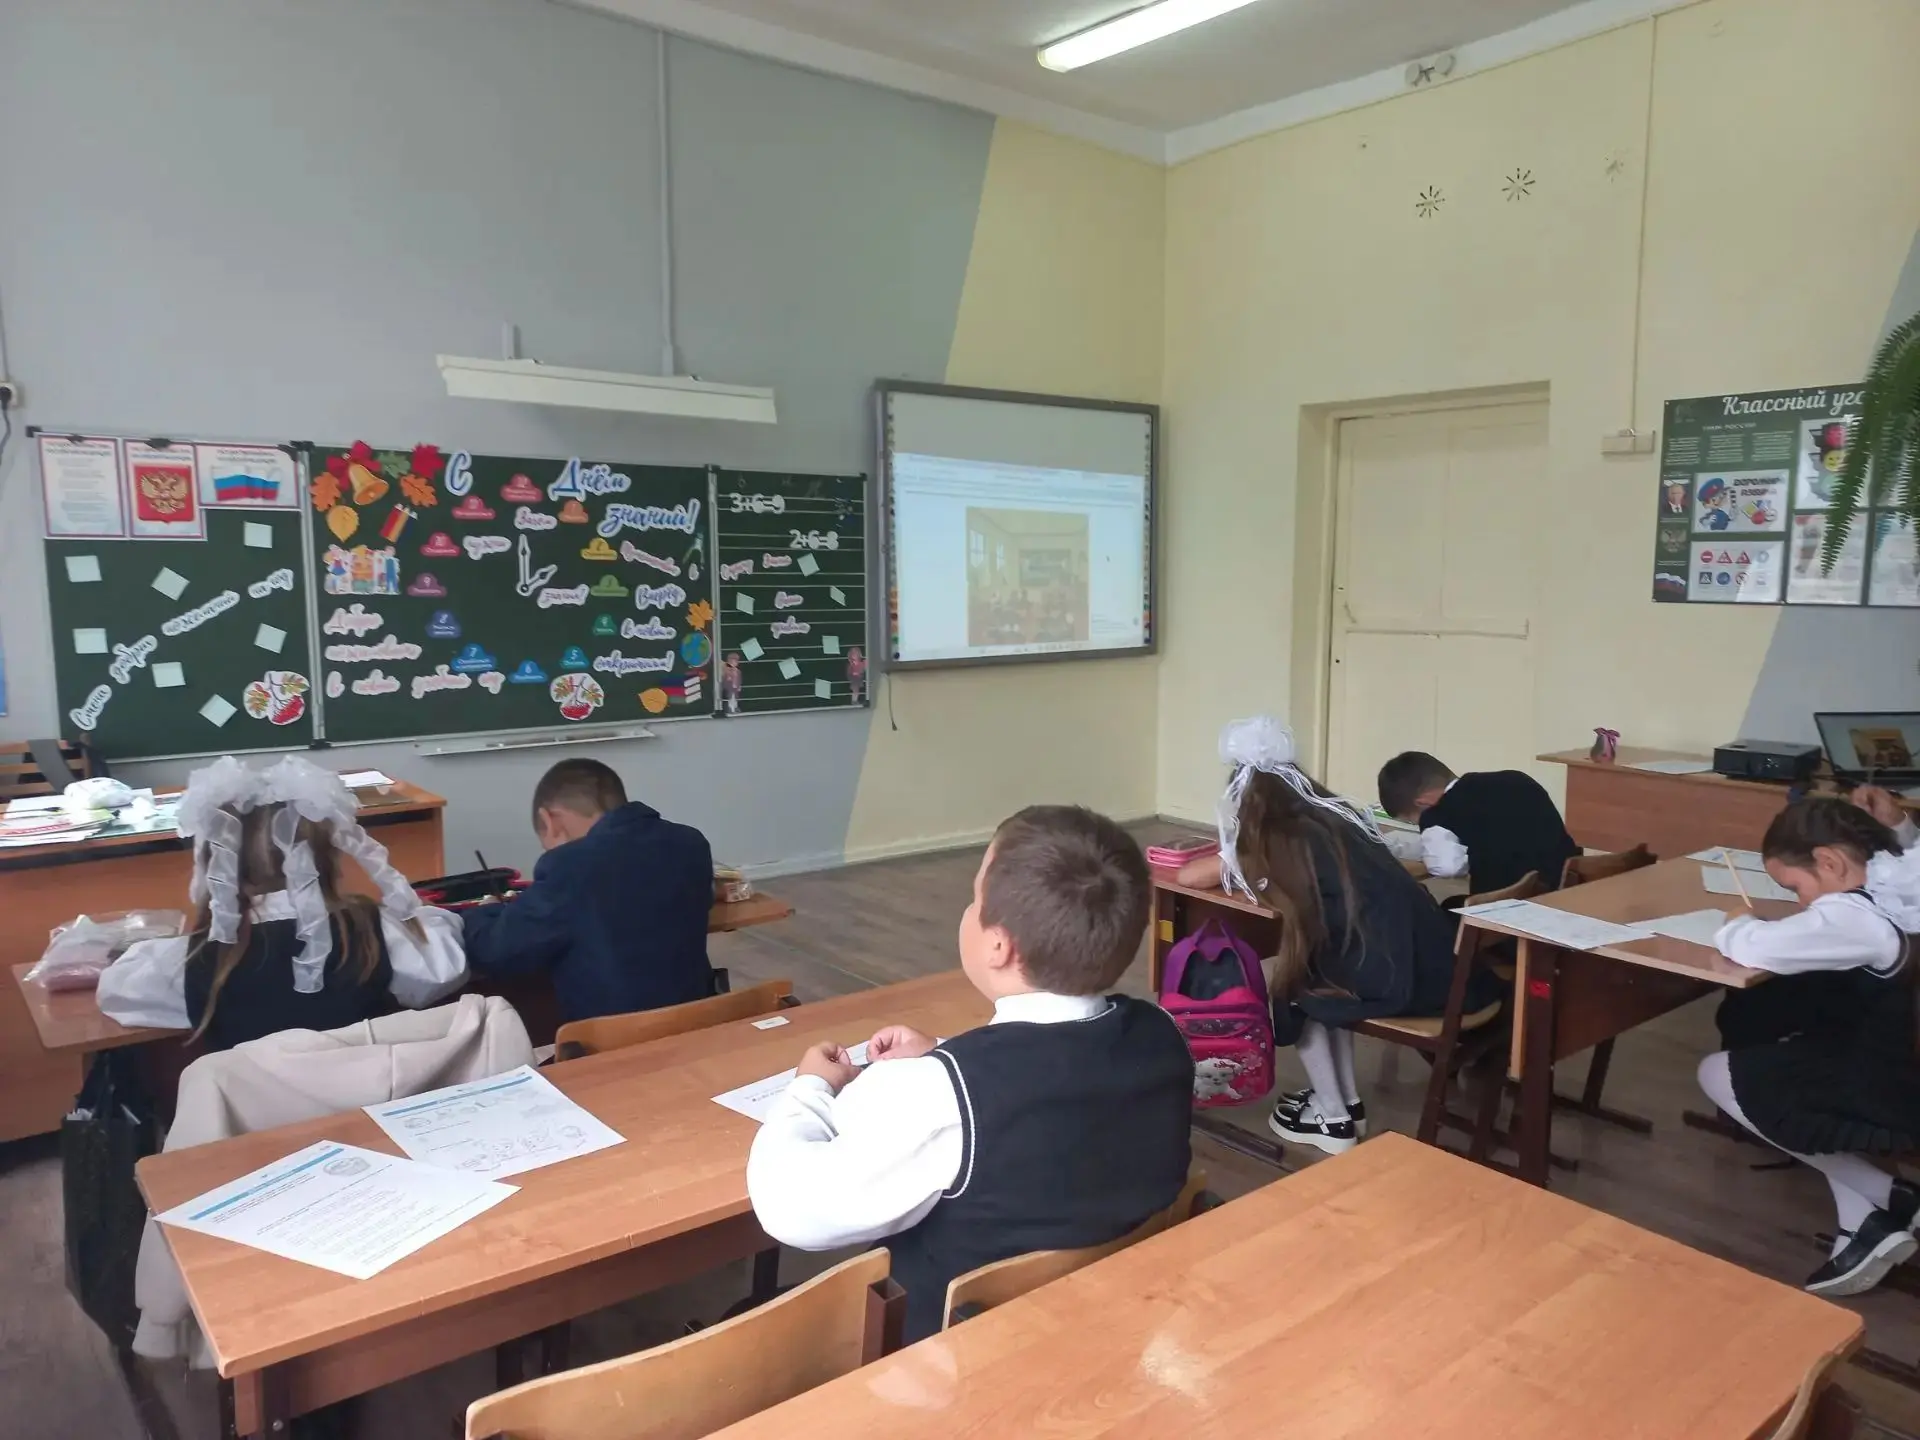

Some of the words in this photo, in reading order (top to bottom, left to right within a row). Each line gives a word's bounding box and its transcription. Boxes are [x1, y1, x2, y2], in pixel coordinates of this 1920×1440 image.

[1722, 390, 1827, 416] Классный
[1830, 391, 1866, 416] уго
[448, 451, 470, 493] С
[550, 458, 627, 497] Днём
[599, 500, 699, 535] знаний!
